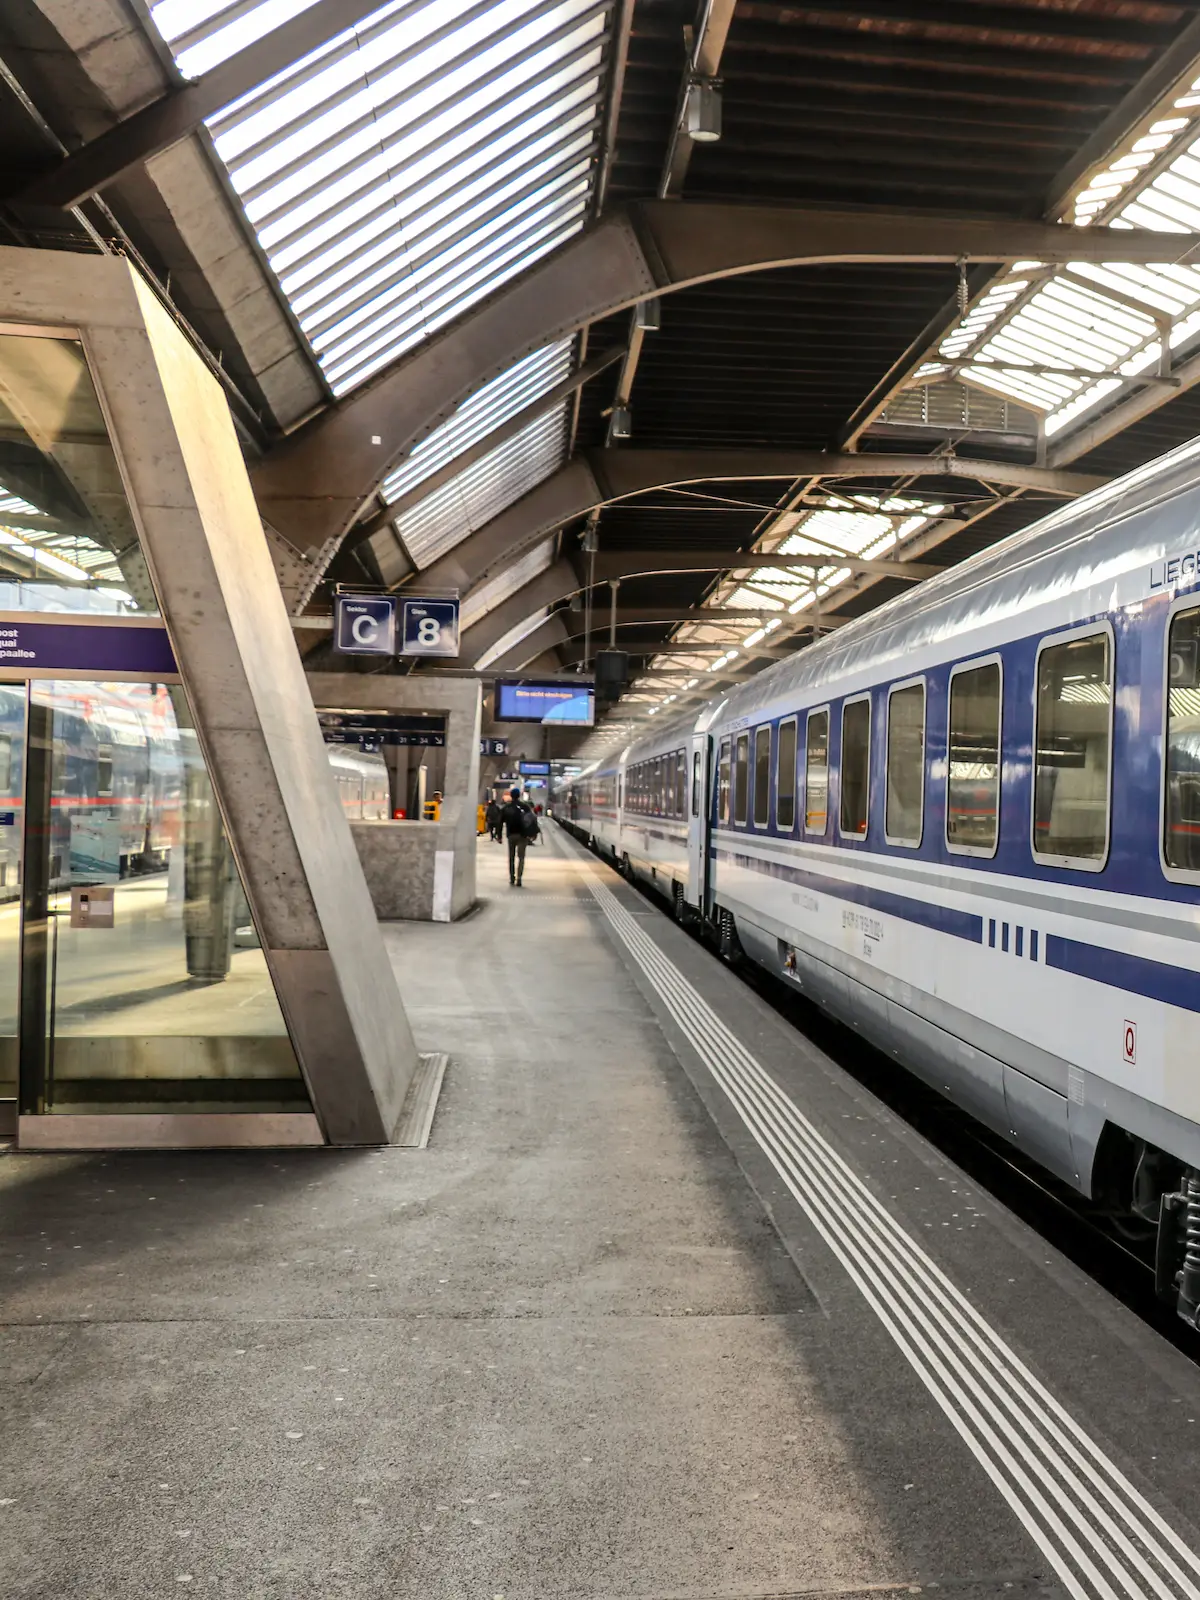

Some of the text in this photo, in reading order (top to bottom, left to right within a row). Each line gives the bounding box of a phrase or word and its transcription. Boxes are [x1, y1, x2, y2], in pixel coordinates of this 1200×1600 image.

[346, 605, 368, 613] Sektor
[0, 629, 19, 638] ost
[352, 615, 378, 644] C
[417, 617, 440, 647] 8
[0, 639, 17, 649] uai
[1125, 1027, 1134, 1057] Q
